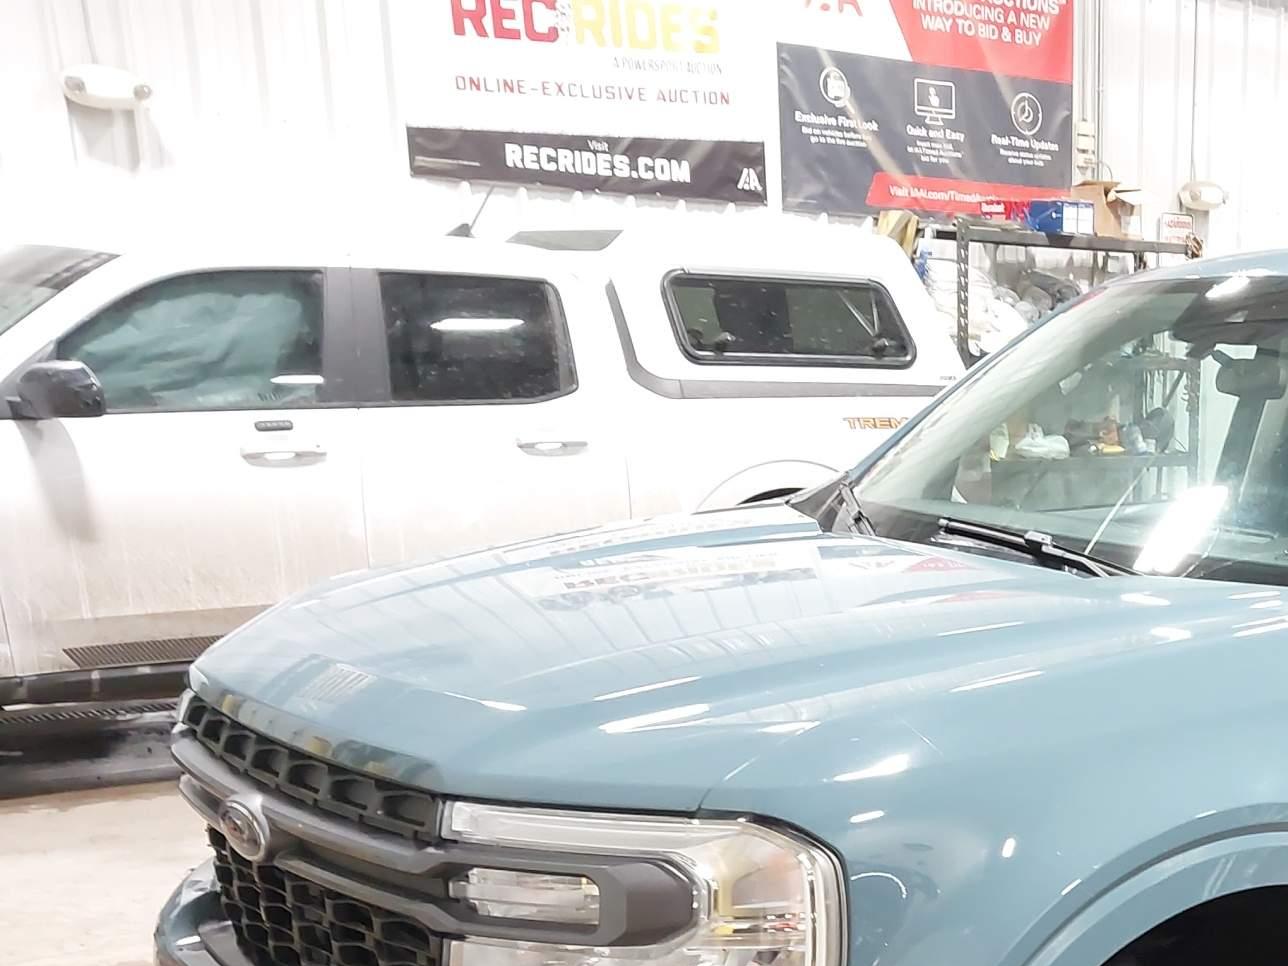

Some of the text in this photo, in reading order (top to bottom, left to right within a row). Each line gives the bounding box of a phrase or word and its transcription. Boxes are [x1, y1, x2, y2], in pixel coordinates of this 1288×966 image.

[913, 0, 1051, 31] INTRODUCING A NEW
[920, 14, 1042, 46] WAY TO BID & BUY
[455, 75, 731, 106] ONLINE-EXCLUSIVE AUCTION
[794, 110, 837, 127] Exclusive
[906, 124, 965, 143] Quick and Easy
[991, 133, 1060, 152] Real-Time Updates
[504, 142, 692, 184] RECRIDES.COM
[889, 184, 909, 199] Visit
